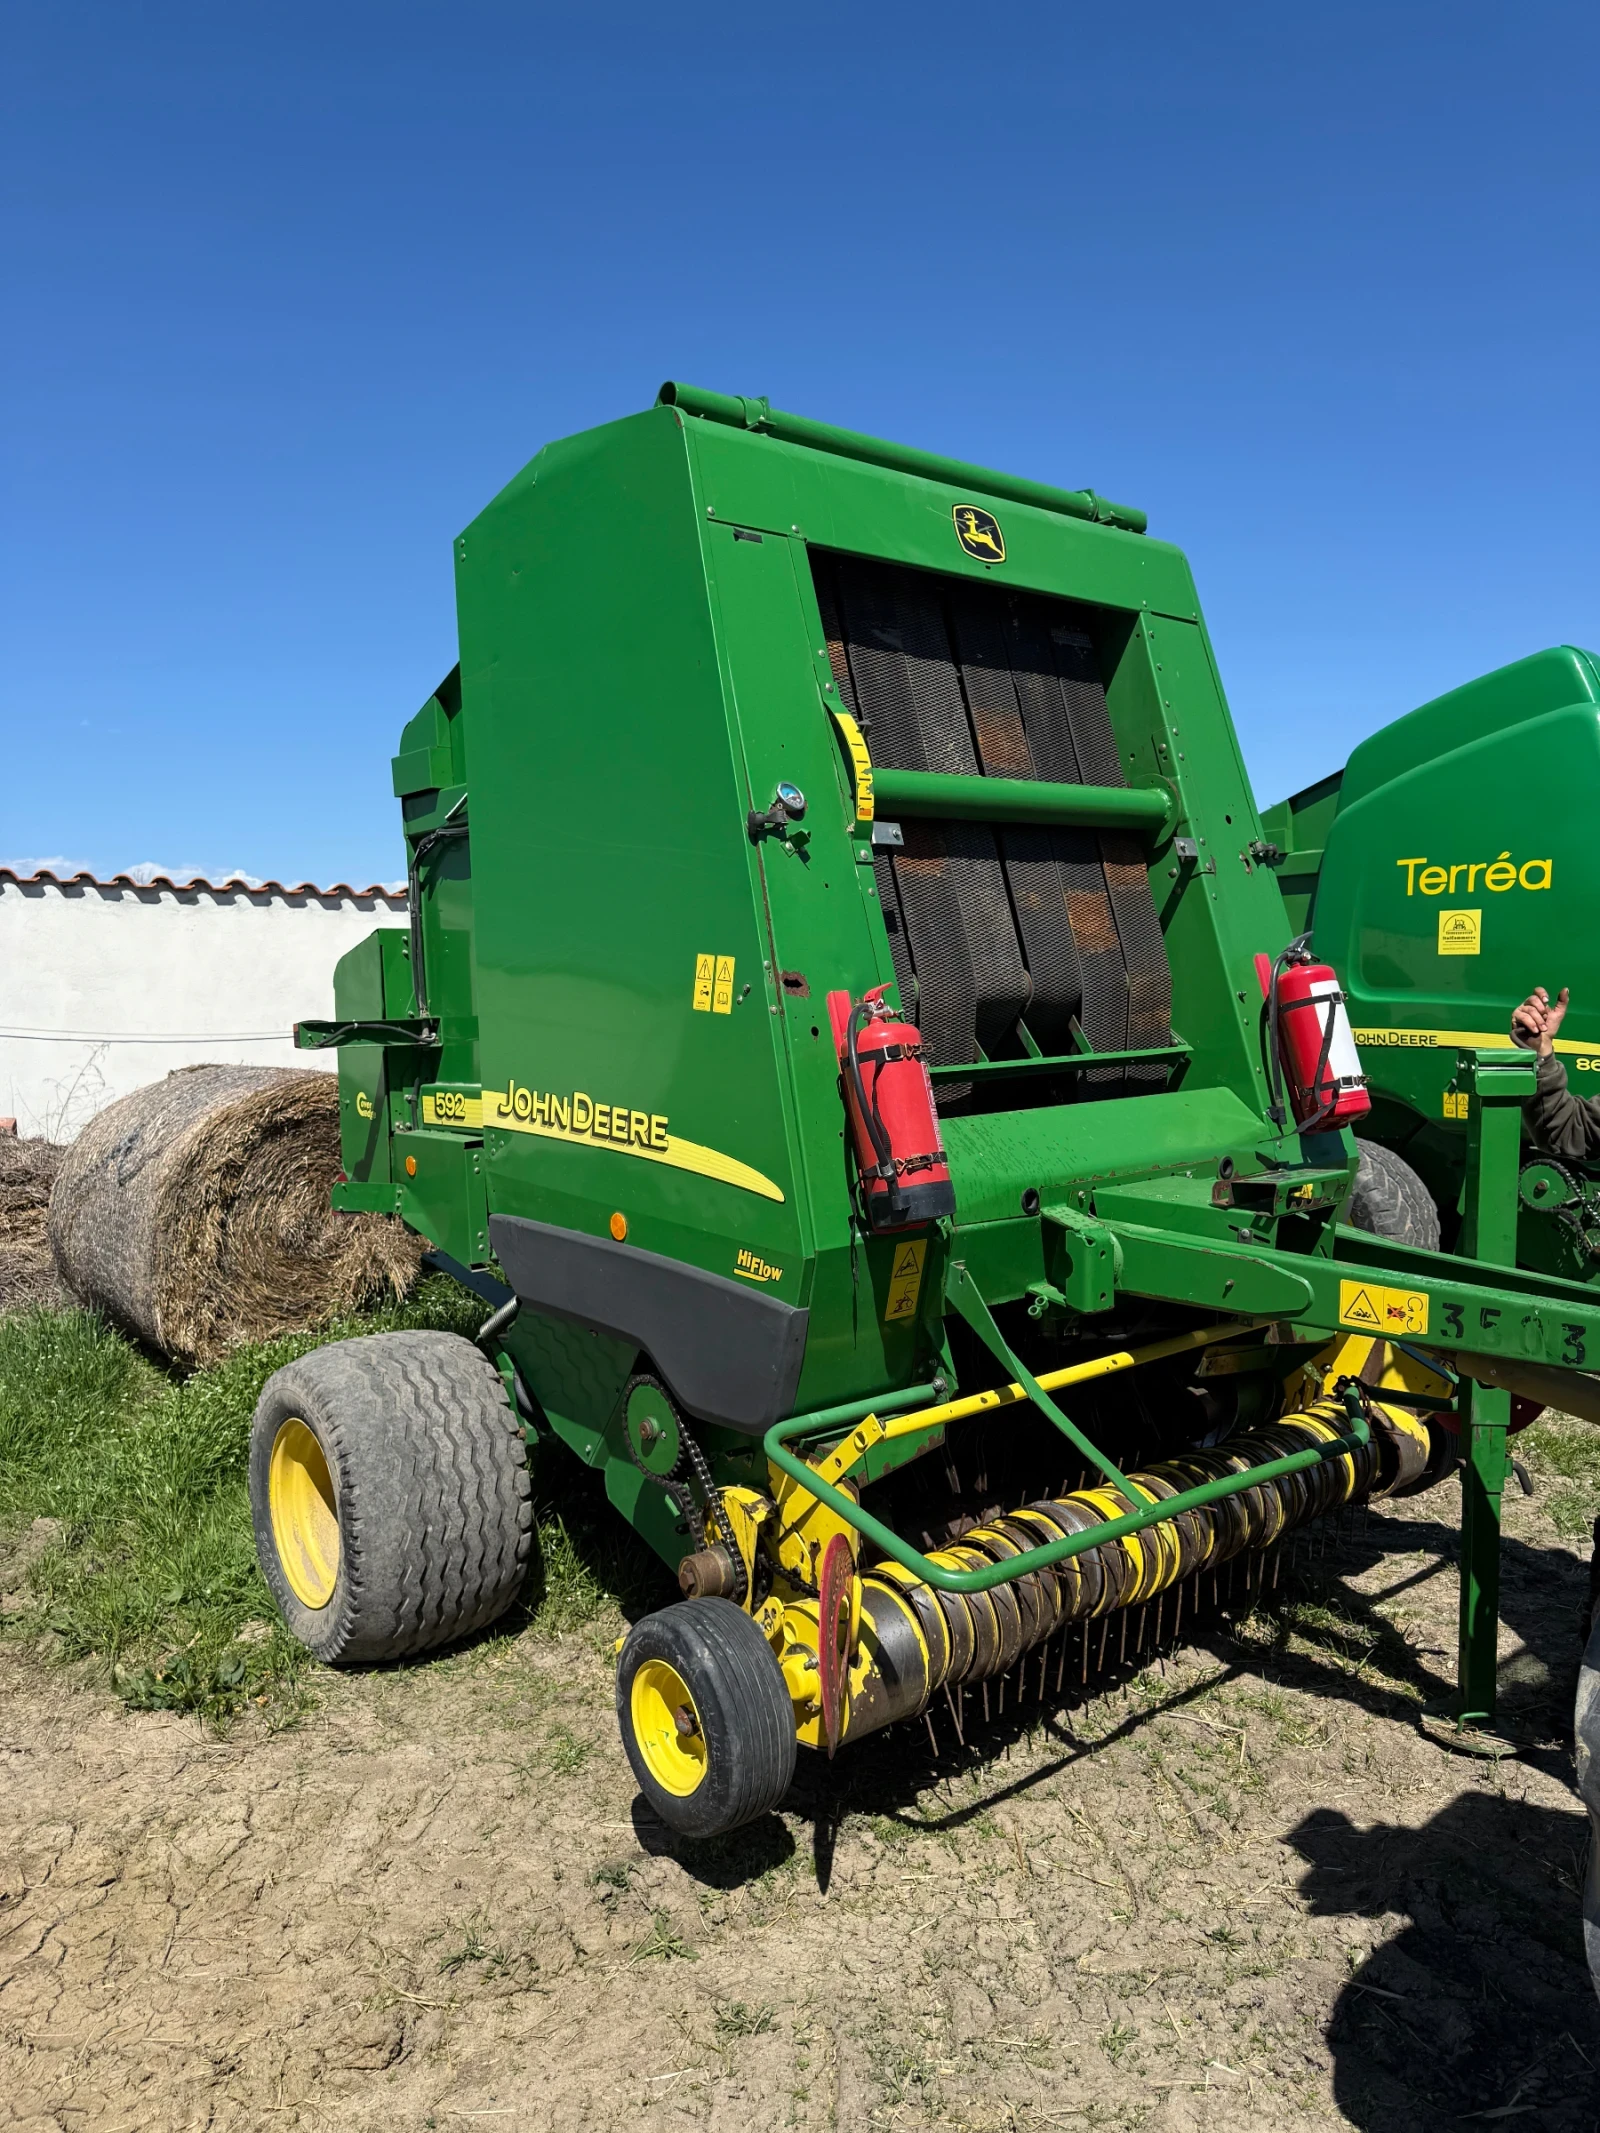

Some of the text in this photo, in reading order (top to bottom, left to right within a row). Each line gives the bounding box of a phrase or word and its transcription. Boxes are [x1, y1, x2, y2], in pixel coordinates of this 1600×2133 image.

[1396, 851, 1553, 896] Terréa
[1388, 1032, 1438, 1046] DEERE
[435, 1092, 466, 1118] 592
[499, 1079, 669, 1151] JOHN DEERE
[737, 1248, 783, 1281] HiFlow
